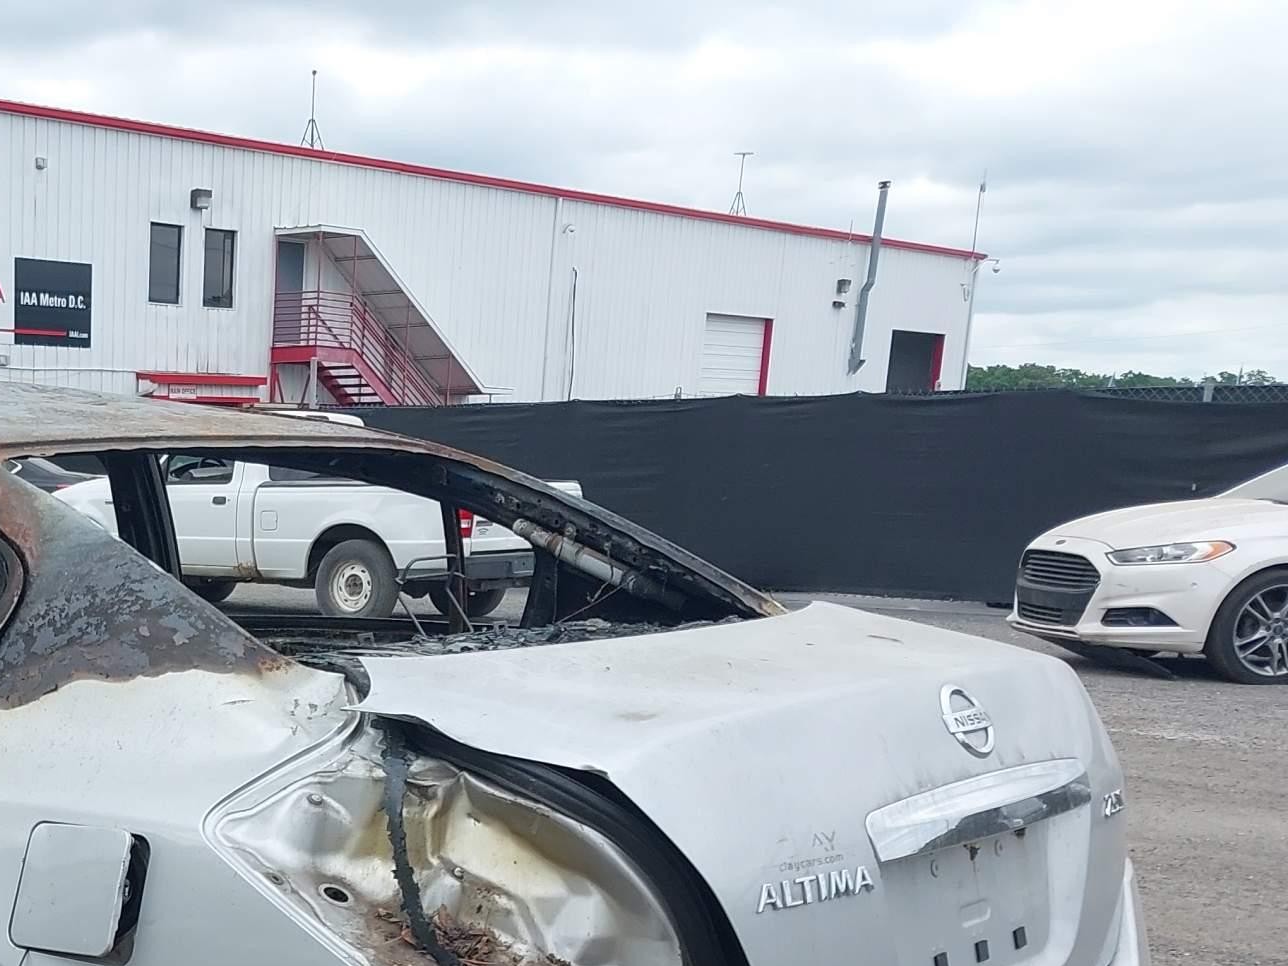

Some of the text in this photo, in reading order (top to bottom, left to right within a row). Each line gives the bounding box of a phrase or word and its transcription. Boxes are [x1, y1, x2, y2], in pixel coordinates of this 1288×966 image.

[20, 291, 87, 310] IAA Metro D.C.
[756, 865, 875, 914] ALTIMA
